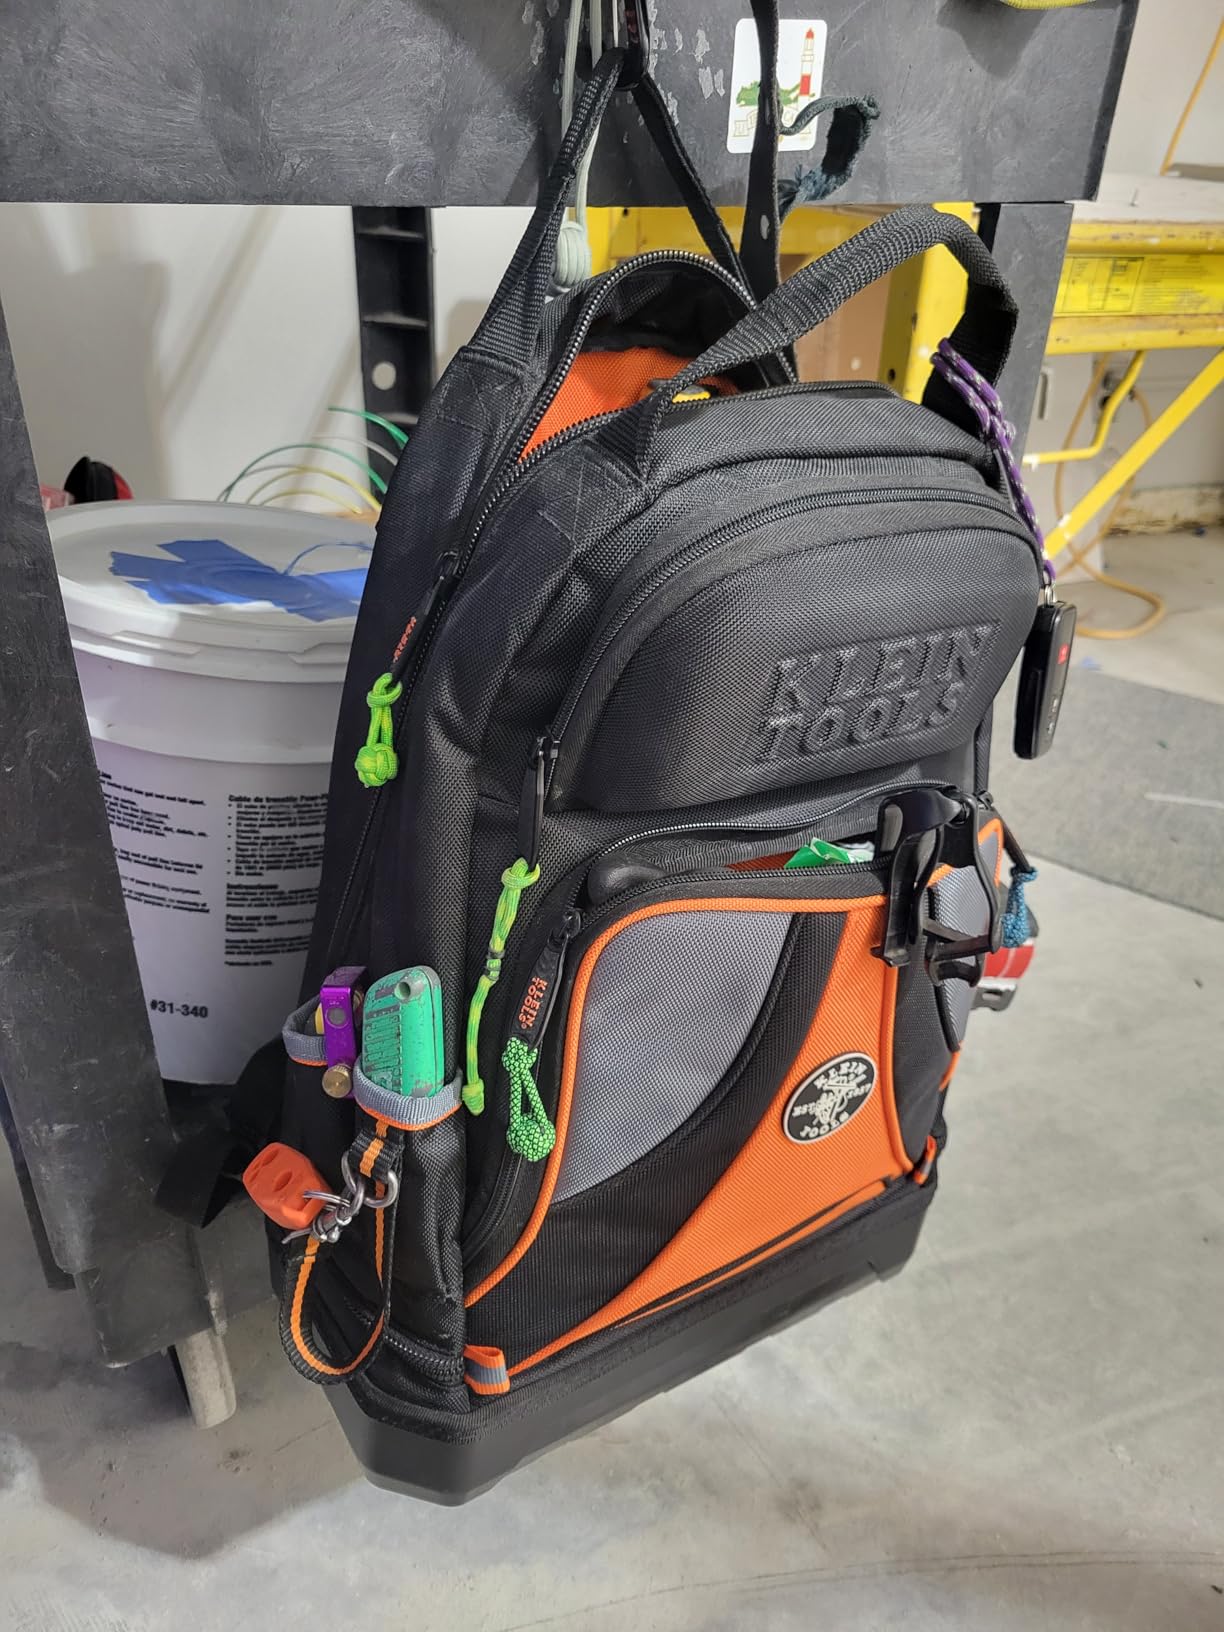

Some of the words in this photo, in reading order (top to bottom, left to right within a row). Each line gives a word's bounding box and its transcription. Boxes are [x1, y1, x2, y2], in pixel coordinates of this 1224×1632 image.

[763, 620, 1002, 712] KLEIN
[753, 681, 964, 761] TOOLS
[150, 999, 209, 1019] #31-340
[526, 980, 548, 1027] KLEIN
[813, 1061, 868, 1089] KLEIN
